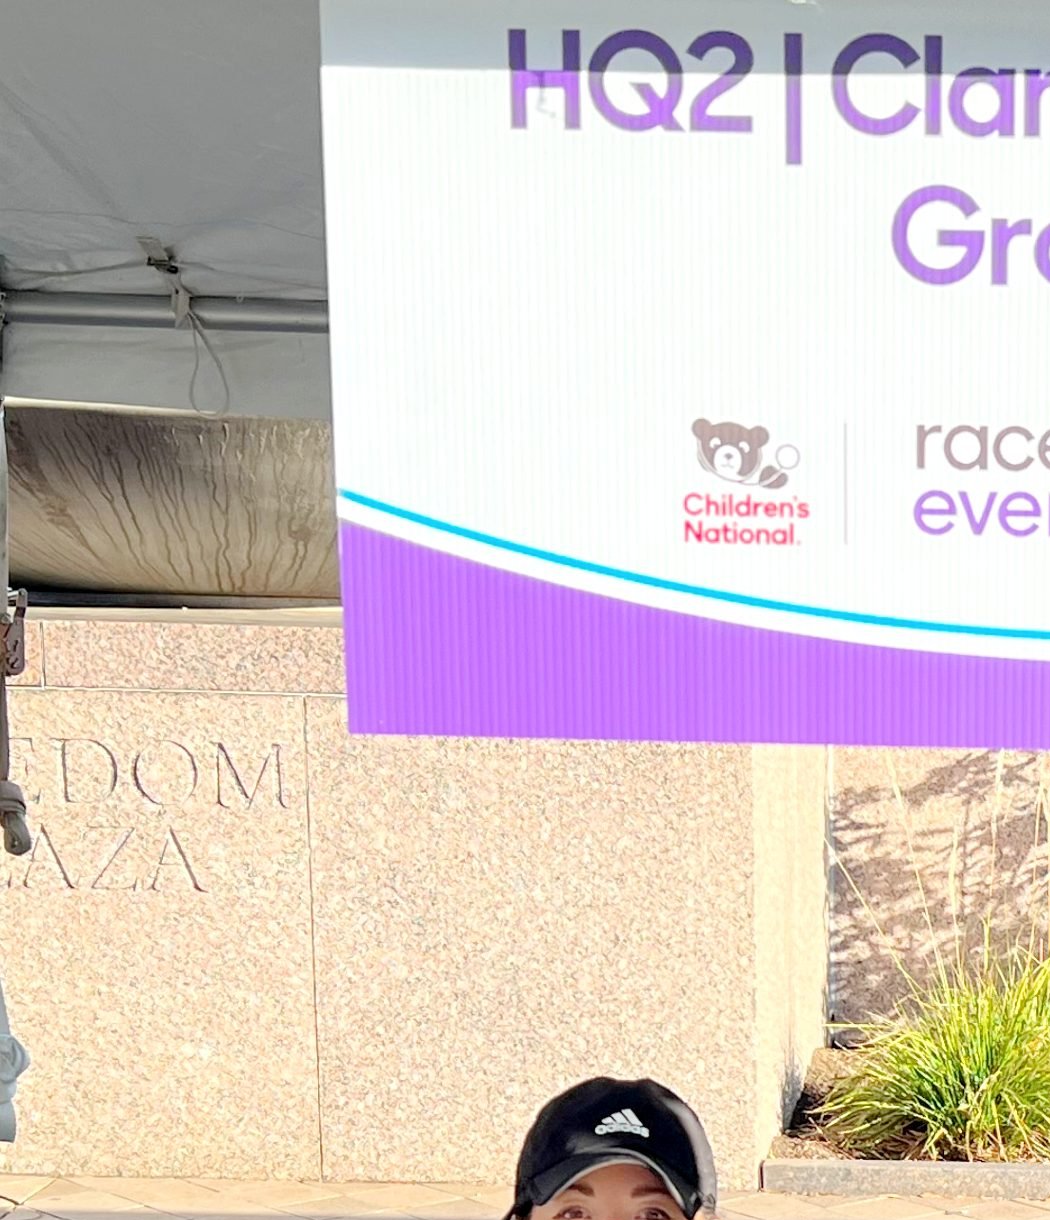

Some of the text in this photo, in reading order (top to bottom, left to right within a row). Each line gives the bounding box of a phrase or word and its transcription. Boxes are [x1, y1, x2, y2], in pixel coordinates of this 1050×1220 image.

[507, 28, 754, 133] HQ2
[684, 492, 810, 519] Children's
[7, 822, 208, 893] AZA
[594, 1123, 650, 1138] adidas
